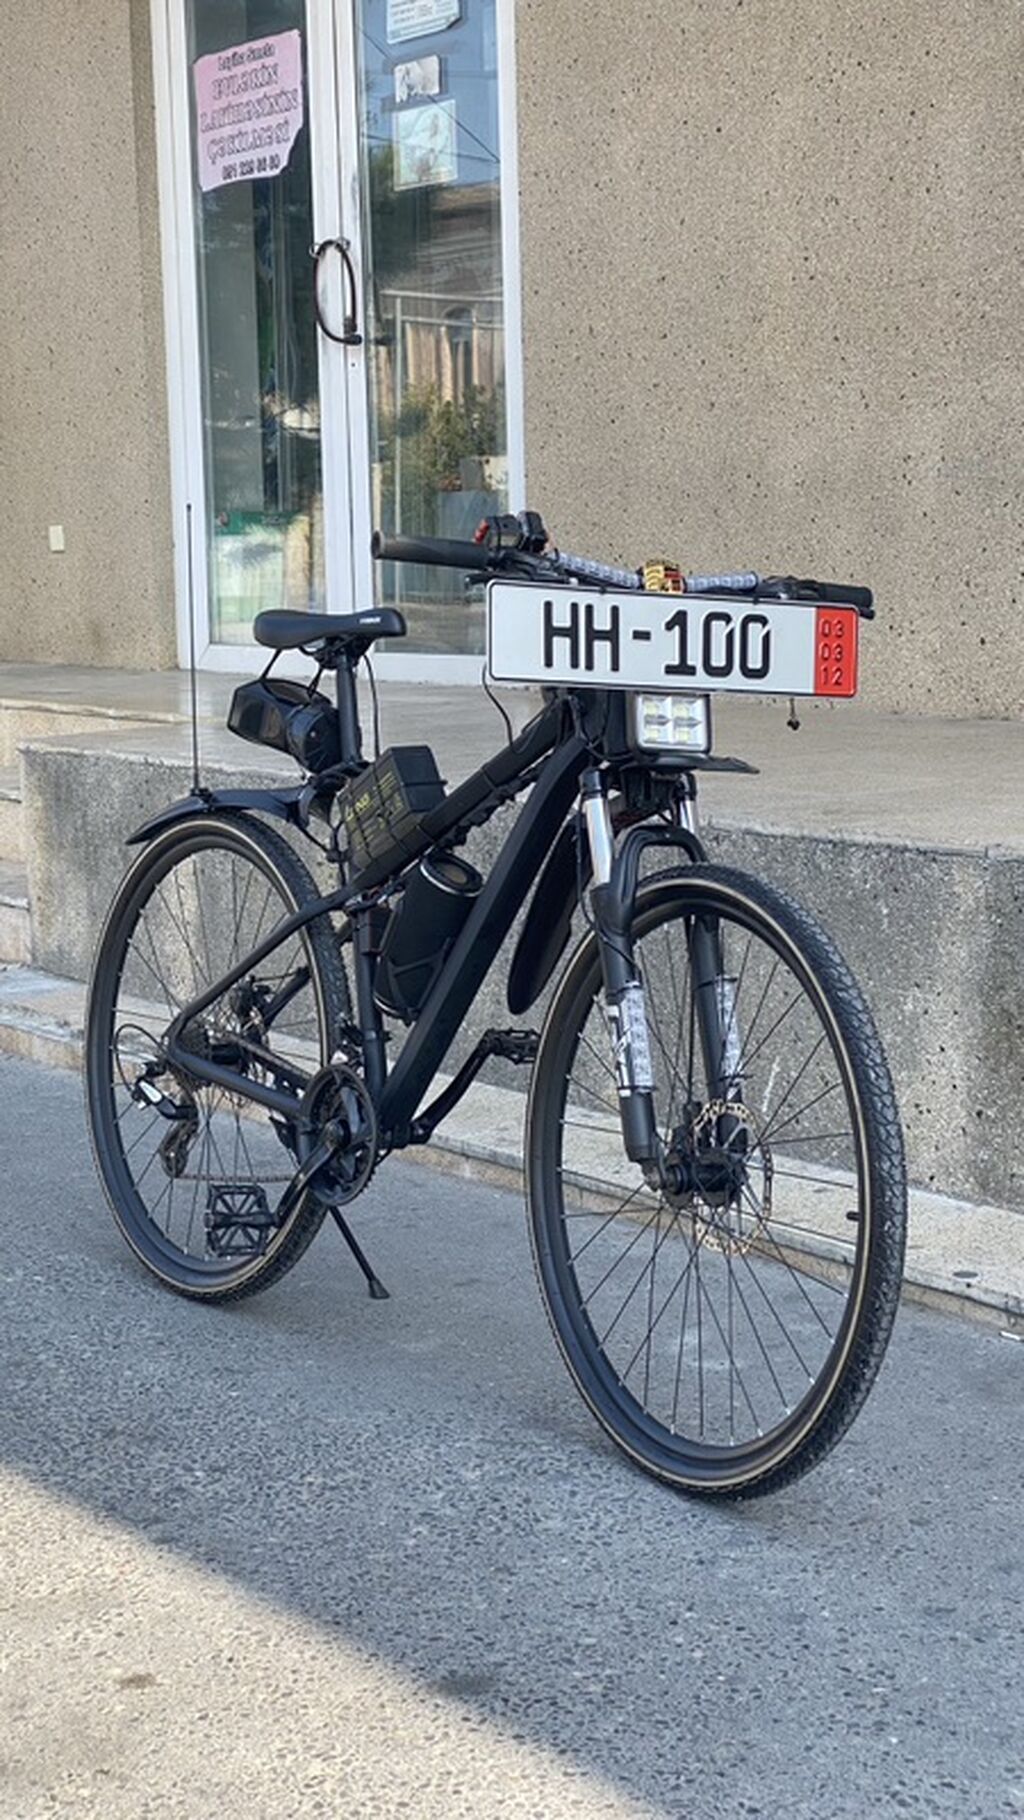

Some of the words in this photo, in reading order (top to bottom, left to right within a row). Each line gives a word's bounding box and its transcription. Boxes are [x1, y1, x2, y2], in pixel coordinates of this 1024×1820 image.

[821, 619, 844, 638] 03
[543, 600, 771, 680] HH-100
[821, 642, 844, 662] 03
[822, 665, 843, 686] 12
